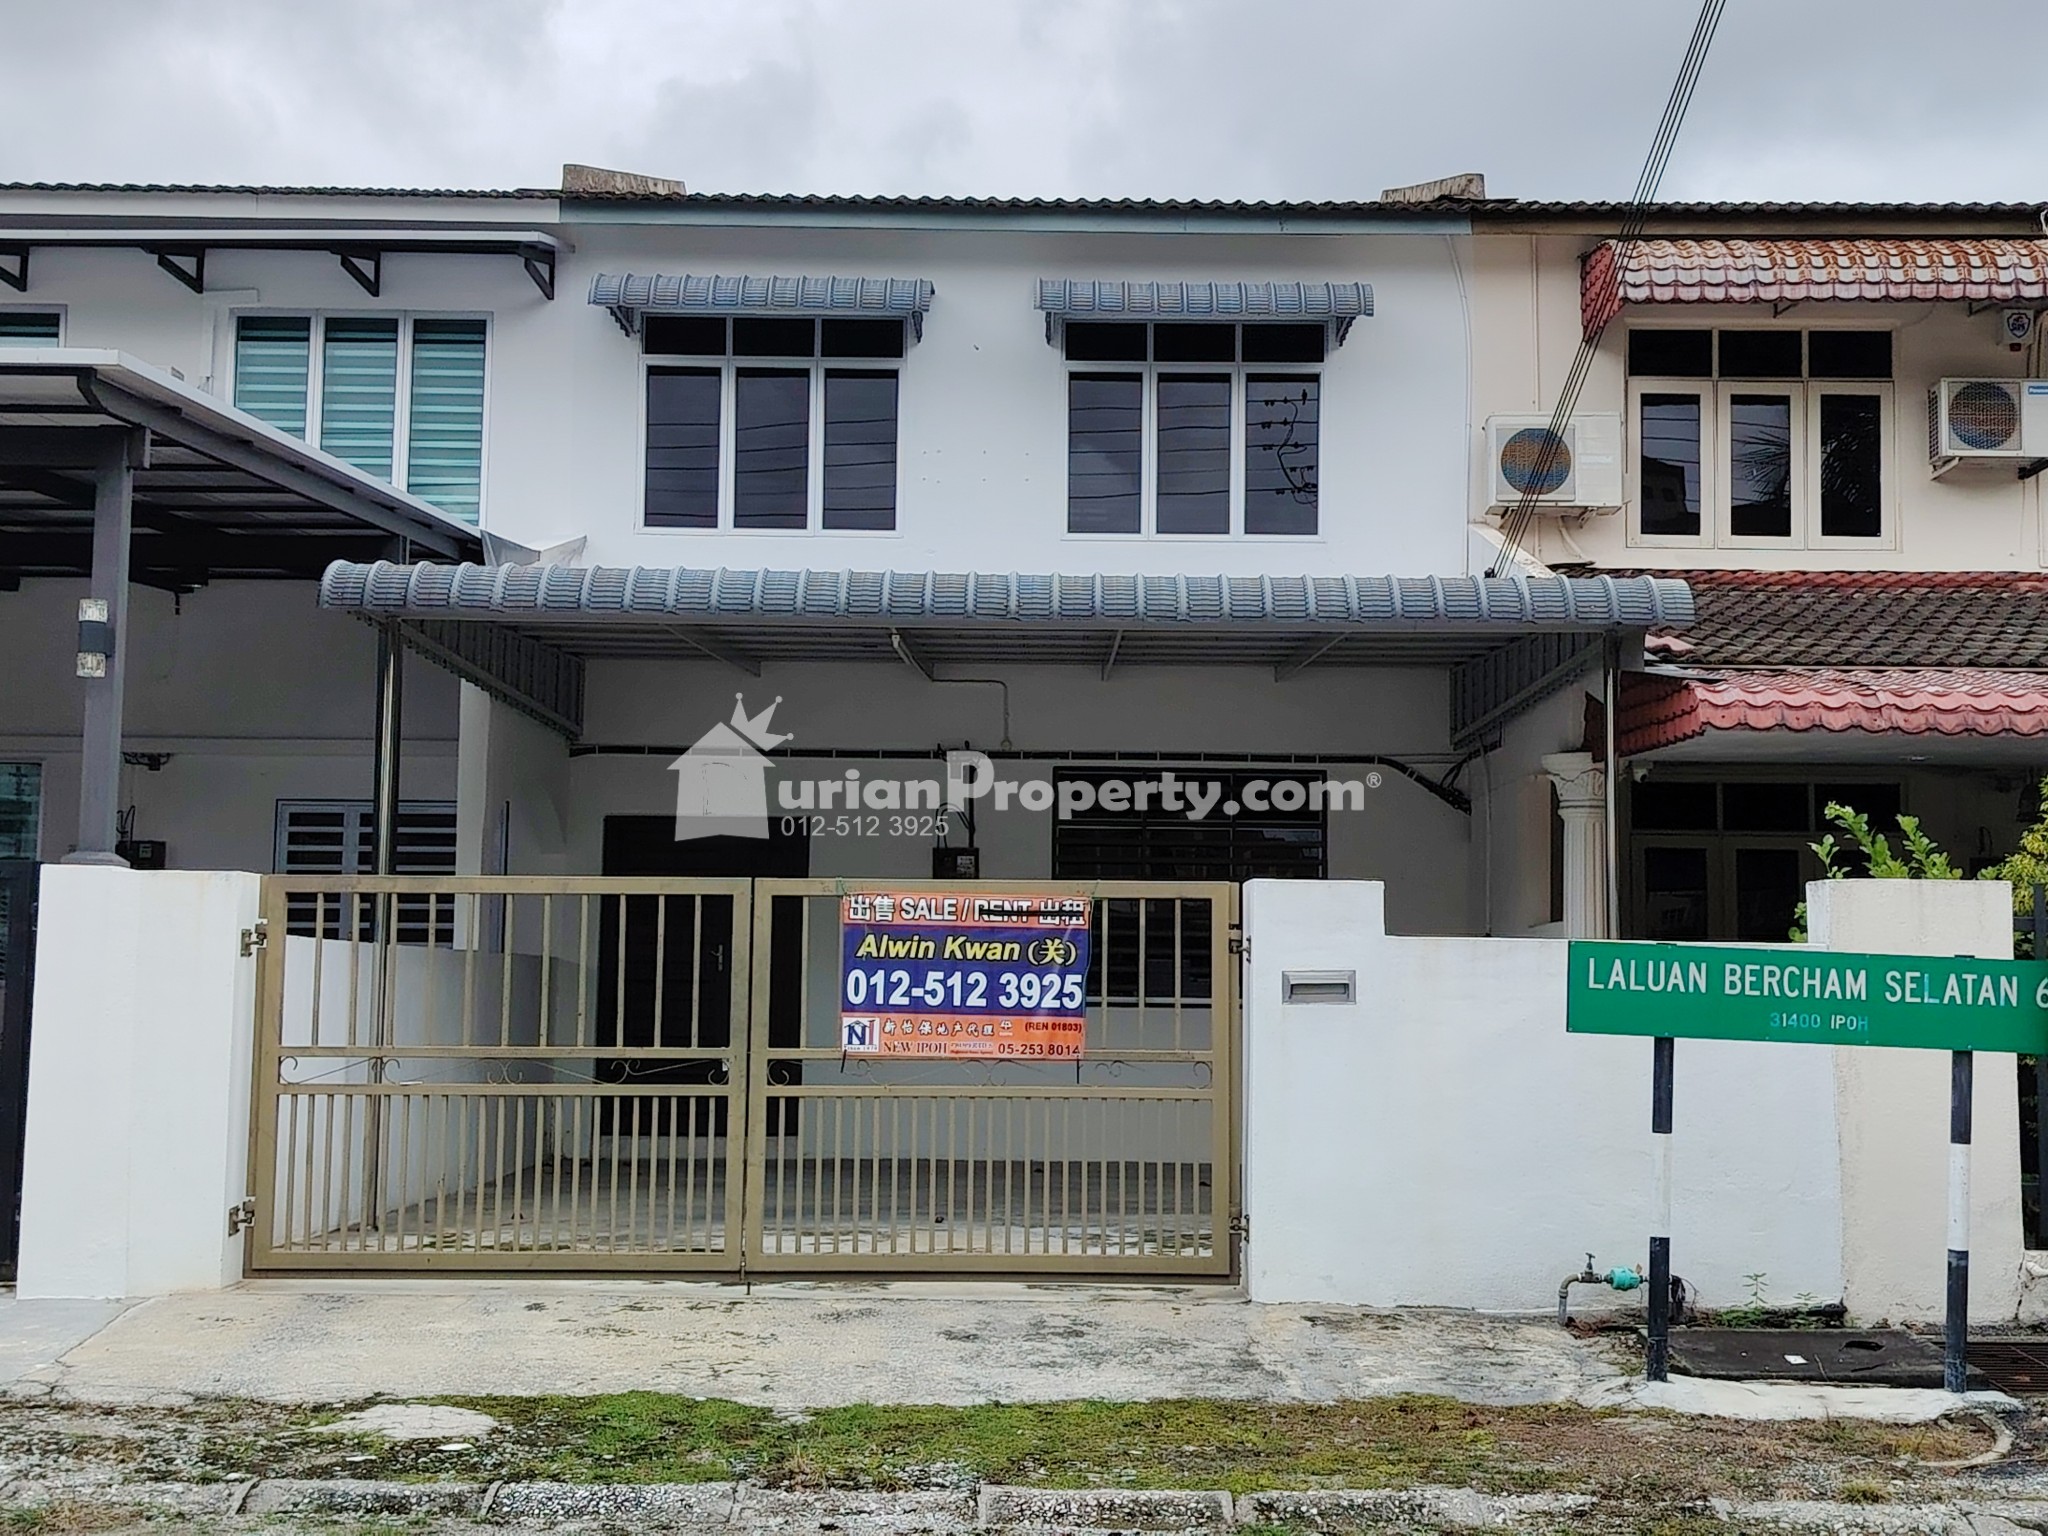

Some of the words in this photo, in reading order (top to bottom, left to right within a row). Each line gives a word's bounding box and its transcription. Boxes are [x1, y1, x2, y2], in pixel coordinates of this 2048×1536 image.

[848, 894, 895, 922] 出售
[900, 897, 958, 921] SALE
[974, 899, 1033, 922] RENT
[856, 933, 937, 960] Alwin
[943, 936, 1021, 961] Kwan
[846, 969, 988, 1008] 012-512
[998, 972, 1083, 1010] 3925
[1588, 957, 1708, 994] LALUAN
[1724, 963, 1867, 1000] BERCHAM
[1885, 970, 2018, 1007] SELATAN
[1025, 1022, 1049, 1032] (REN
[1770, 1012, 1821, 1029] 31400
[1830, 1014, 1869, 1031] IPOH
[883, 1042, 914, 1053] NEW
[916, 1042, 948, 1054] IPOH
[998, 1043, 1044, 1055] 05-253
[1048, 1044, 1080, 1056] 8014
